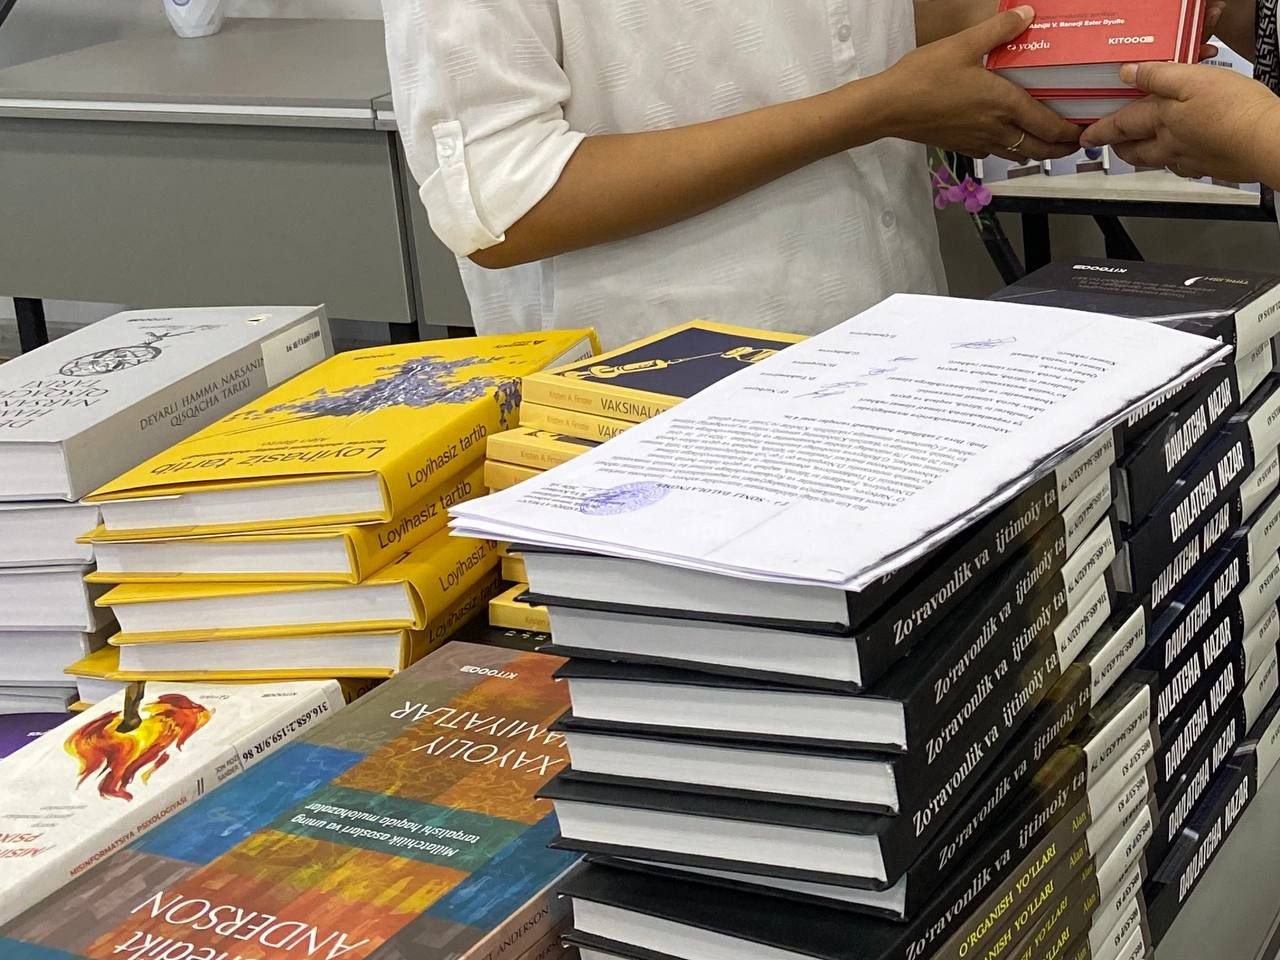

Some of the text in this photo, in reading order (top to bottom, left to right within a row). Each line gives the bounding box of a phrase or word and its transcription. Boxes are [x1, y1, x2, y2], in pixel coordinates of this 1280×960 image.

[139, 401, 179, 430] DEYARLI
[181, 382, 220, 410] HAMMA
[170, 376, 252, 427] QISQACHA TARIXI
[1164, 404, 1208, 473] DAVLATCHA
[1207, 377, 1232, 424] NAZAR
[150, 446, 386, 475] Loyihasiz tartib
[408, 444, 459, 488] Loyihasiz
[459, 423, 487, 451] tartib
[378, 503, 438, 550] Loyihasiz
[439, 480, 472, 510] tartib
[1169, 441, 1245, 543] DAVLATCHA NAZAR
[439, 549, 487, 592] Loyihasiz
[974, 548, 990, 572] va
[995, 503, 1041, 553] ijtimoiy
[1151, 502, 1231, 610] DAVLATCHA NAZAR
[999, 601, 1012, 624] va
[1015, 553, 1053, 605] ijtimoiy
[1164, 557, 1240, 669] DAVLATCHA NAZAR
[994, 658, 1009, 682] va
[1012, 607, 1052, 662] ijtimoiy
[389, 700, 566, 748] AMIYATLAR
[984, 725, 999, 749] va
[1002, 659, 1045, 728] ijtimoiy
[241, 748, 255, 764] 86
[412, 736, 565, 777] XAYOLIY
[69, 830, 135, 878] MISINFORMATSIYA
[290, 814, 460, 857] Millatchilik asoslari va uning
[304, 802, 480, 844] tarqalishi haqida mulohazalar
[1178, 775, 1249, 903] DAVLATCHA NAZAR
[130, 891, 371, 960] ANDERSON
